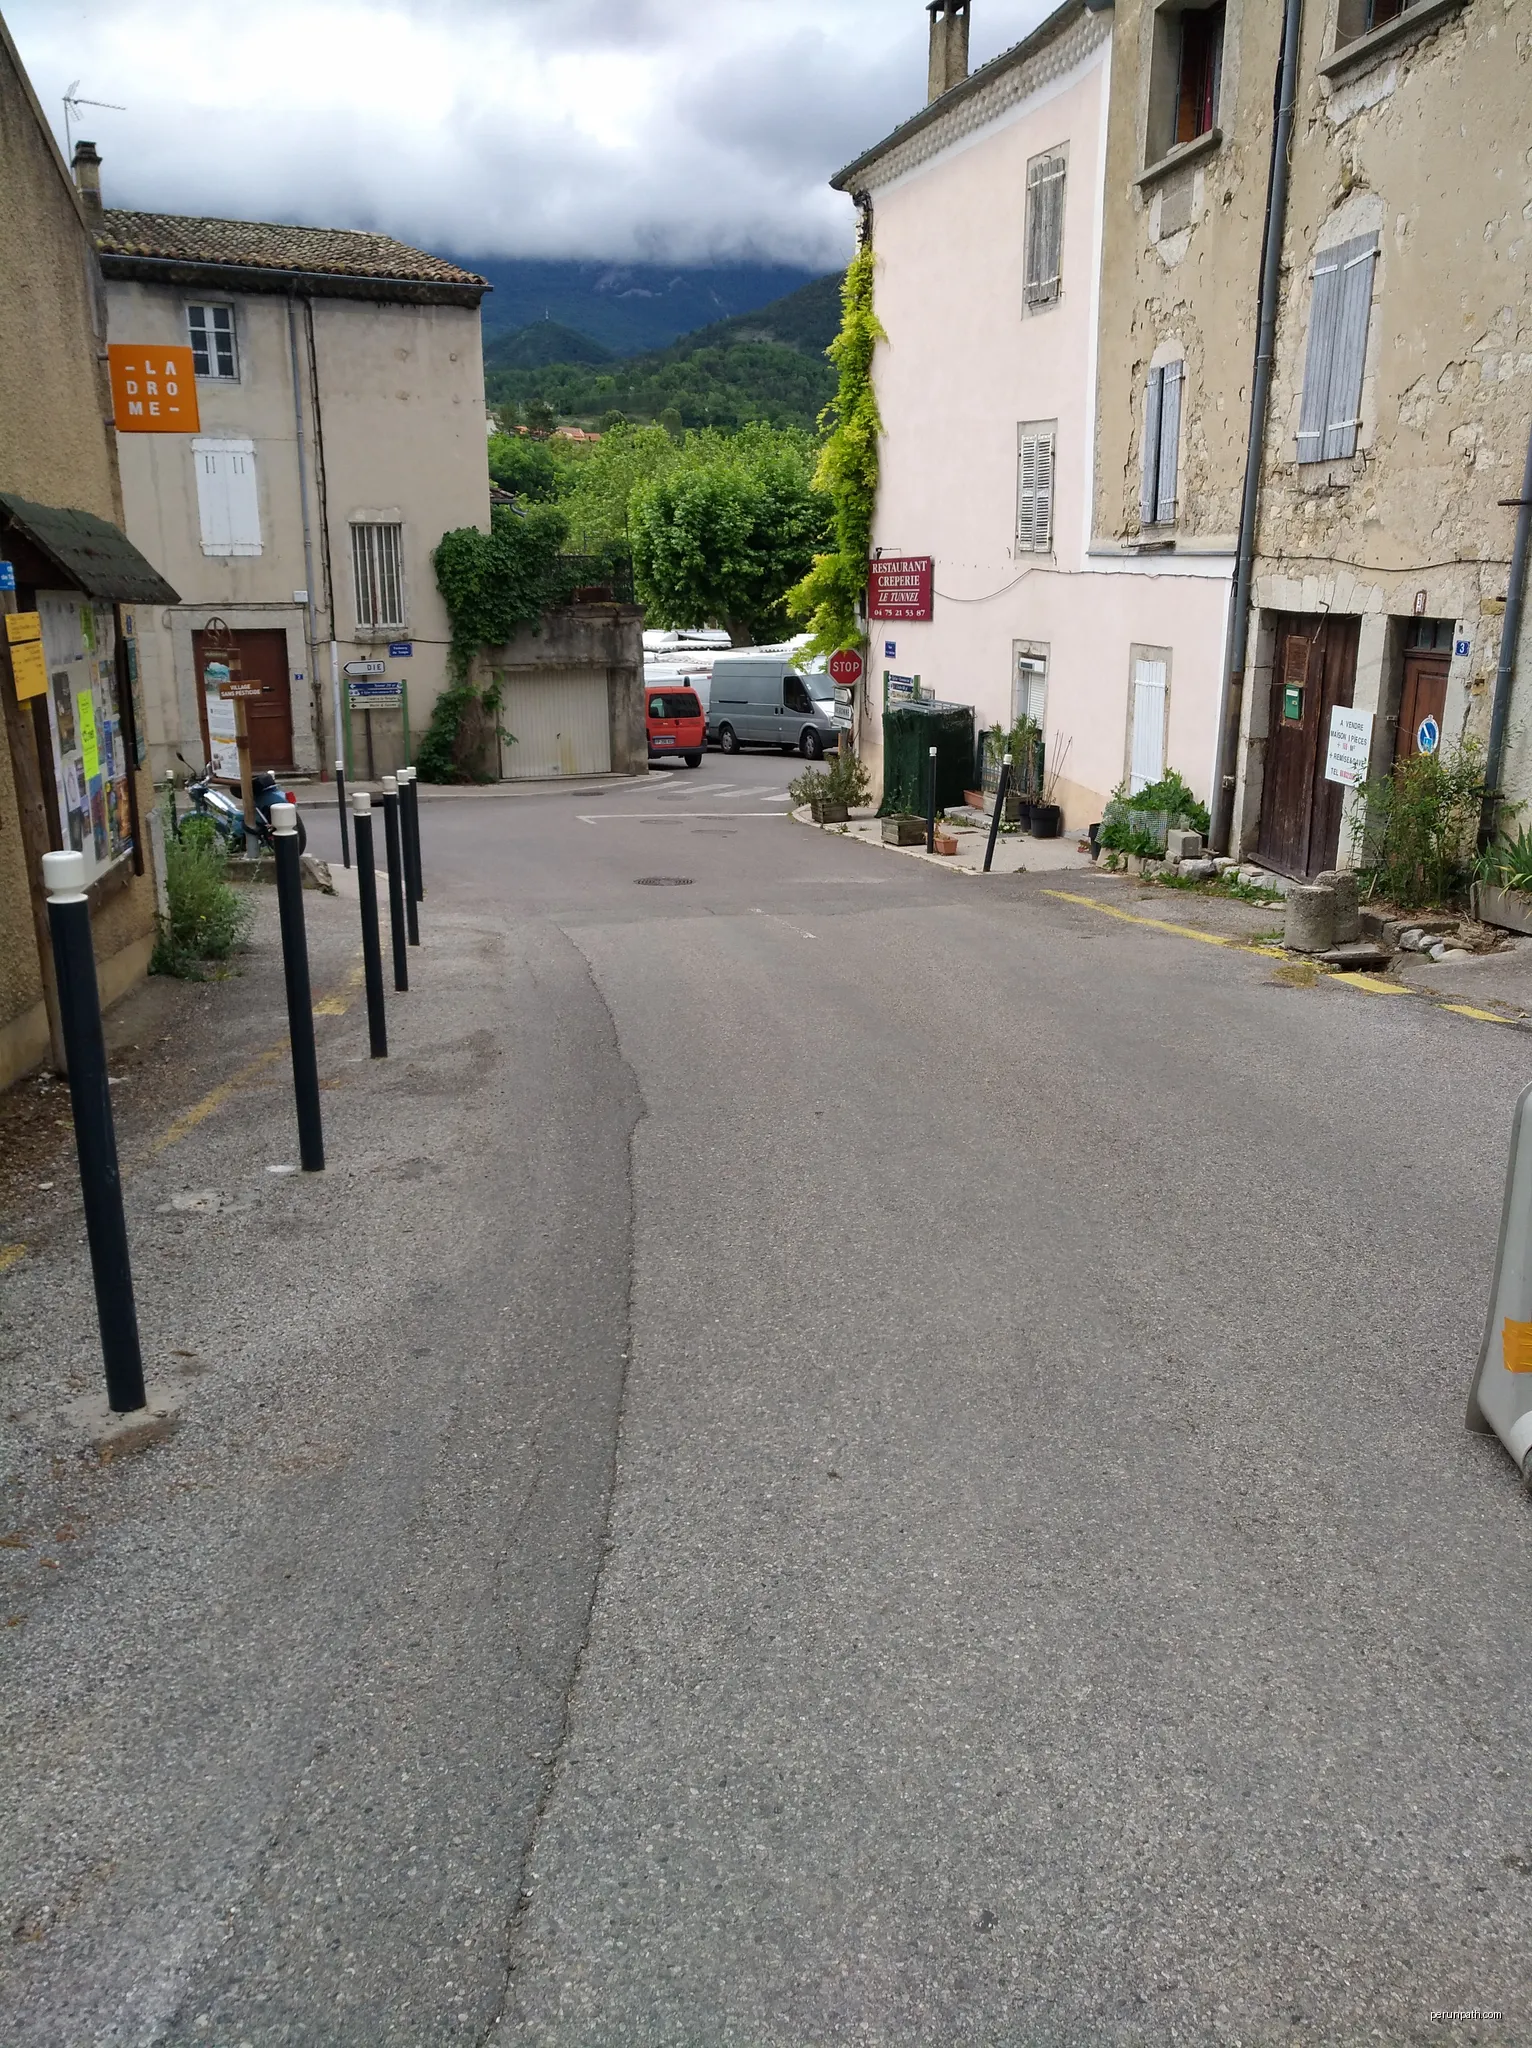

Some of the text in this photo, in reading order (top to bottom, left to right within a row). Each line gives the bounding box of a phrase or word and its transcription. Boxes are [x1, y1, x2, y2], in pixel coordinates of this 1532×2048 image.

[872, 561, 927, 574] RESTAURANT
[878, 575, 920, 587] CREPERIE
[878, 592, 919, 602] LE TUNNEL
[916, 609, 925, 617] 87
[1459, 643, 1465, 653] 3
[367, 663, 382, 671] DIE
[832, 661, 860, 673] STOP
[1346, 721, 1364, 732] VENDRE
